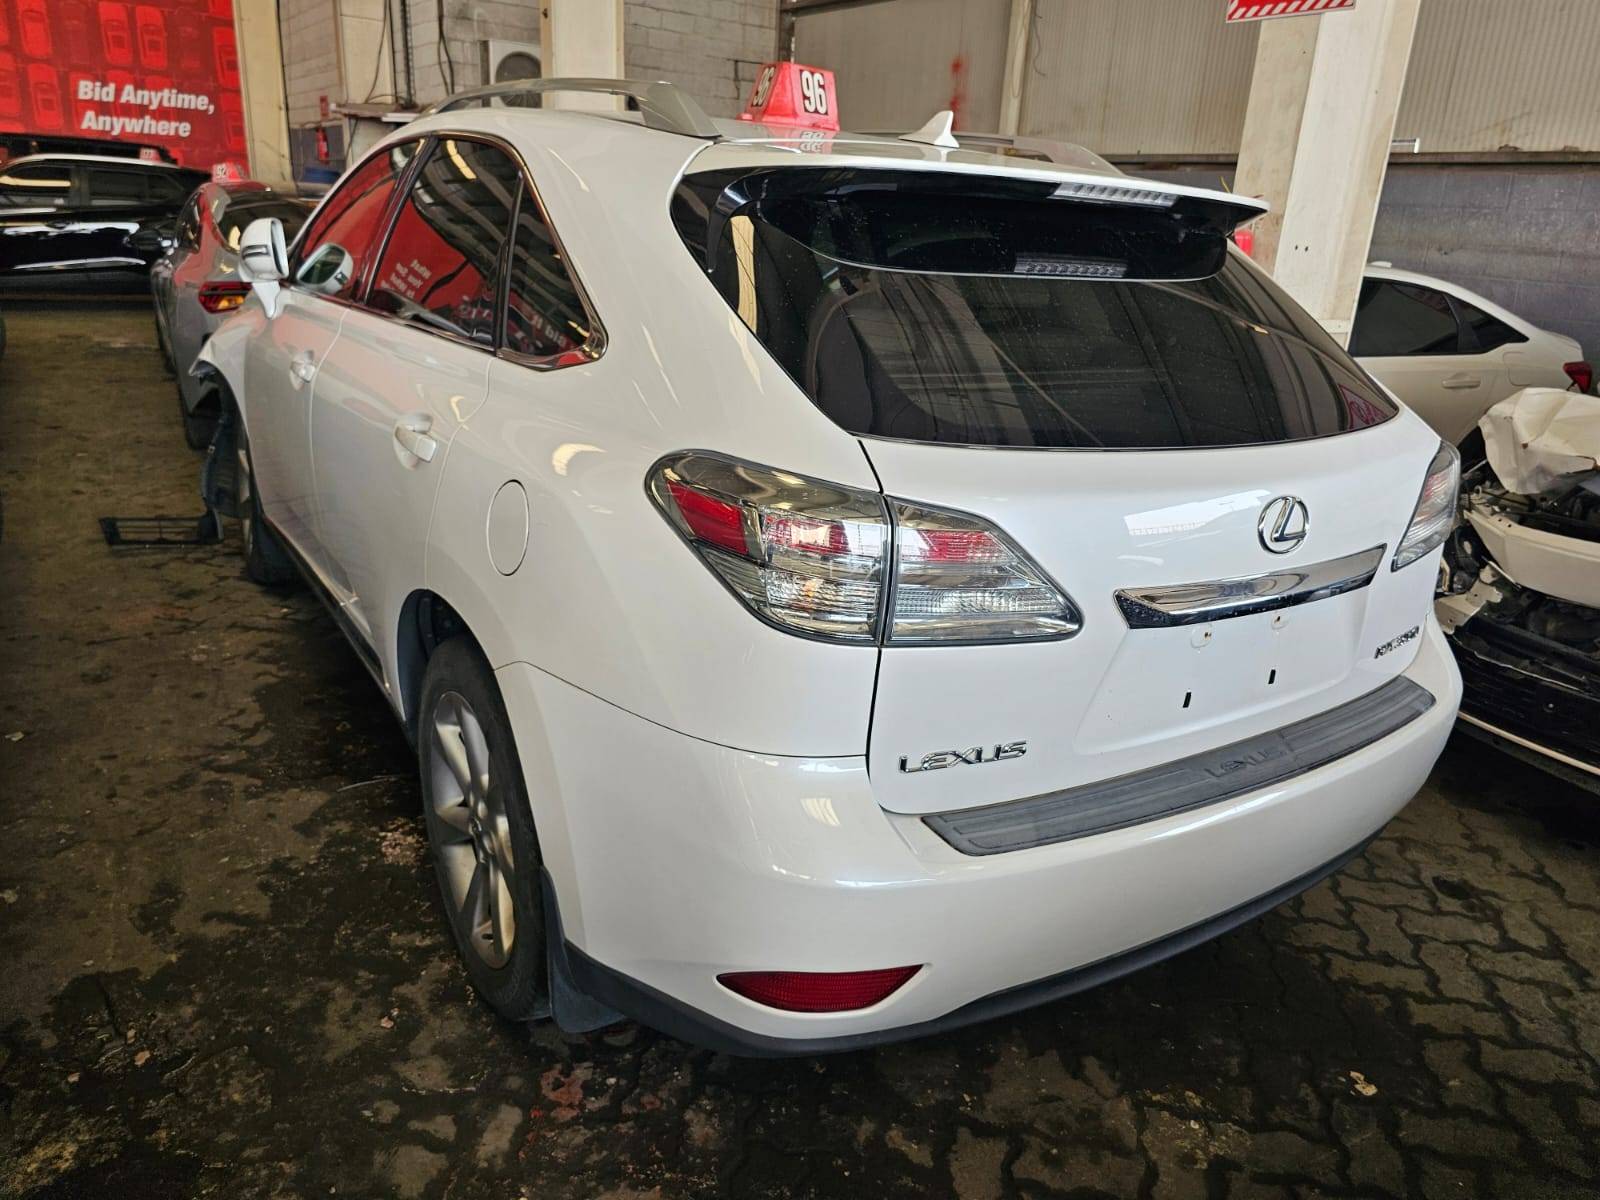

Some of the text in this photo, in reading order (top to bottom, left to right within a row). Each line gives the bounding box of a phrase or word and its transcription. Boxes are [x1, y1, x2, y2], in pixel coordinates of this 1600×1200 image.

[77, 80, 215, 115] Bid Anytime,
[800, 69, 828, 115] 96
[80, 110, 192, 138] Anywhere
[898, 739, 1028, 774] LEXUS
